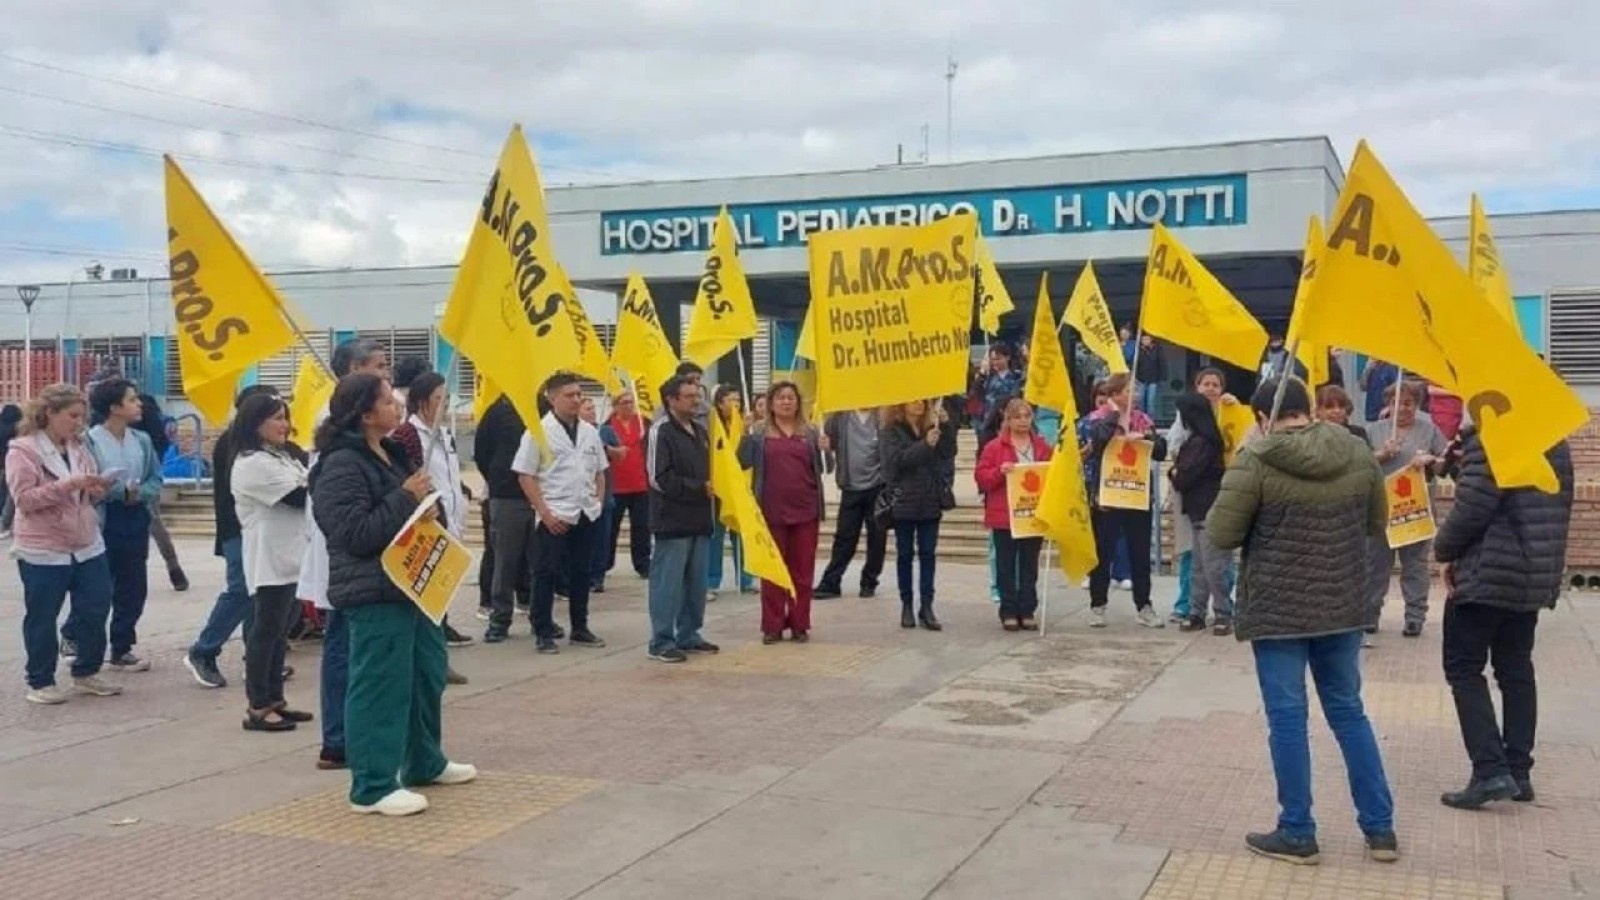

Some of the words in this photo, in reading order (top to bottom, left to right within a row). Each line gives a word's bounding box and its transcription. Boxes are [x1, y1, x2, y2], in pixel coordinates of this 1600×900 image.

[1054, 194, 1092, 228] H.
[1107, 184, 1235, 226] NOTTI
[828, 234, 978, 298] A.M.Pro.S.
[829, 298, 910, 335] Hospital
[832, 342, 860, 370] Dr.
[863, 330, 951, 367] Humberto
